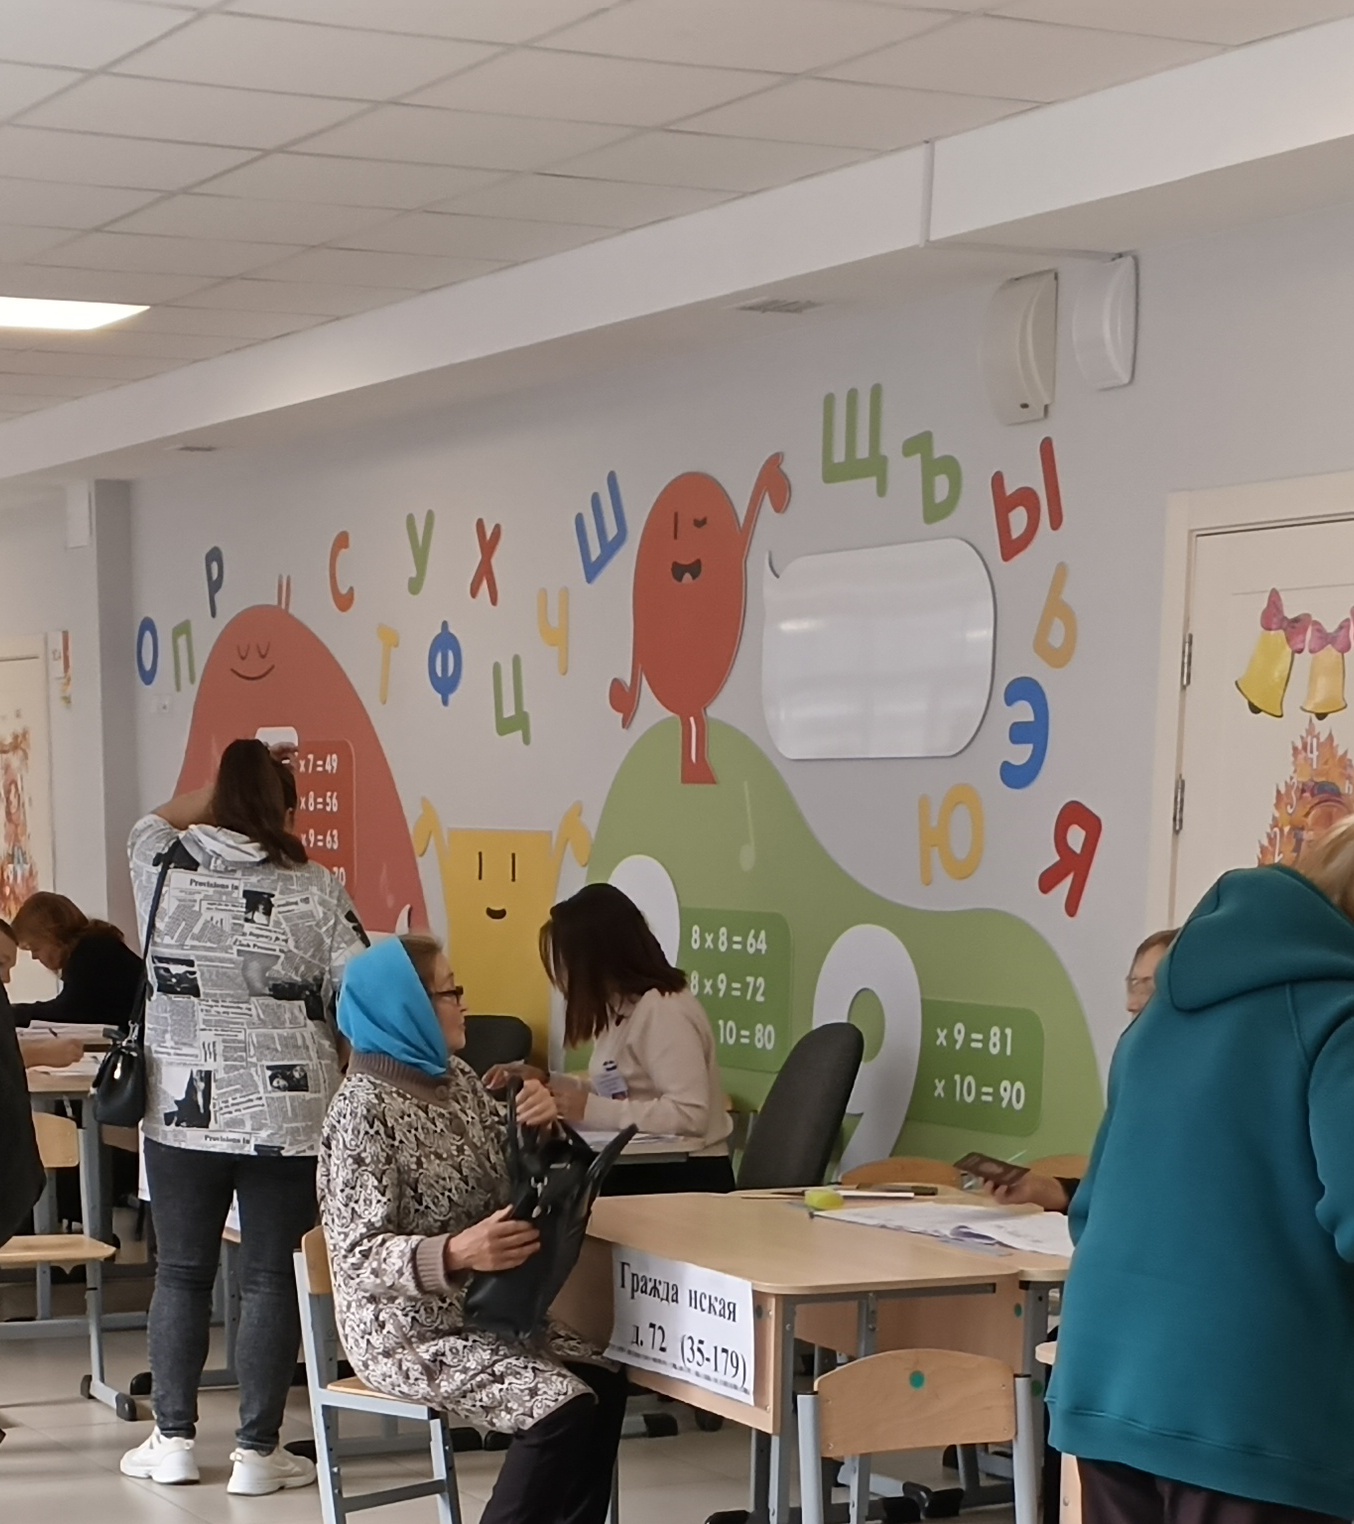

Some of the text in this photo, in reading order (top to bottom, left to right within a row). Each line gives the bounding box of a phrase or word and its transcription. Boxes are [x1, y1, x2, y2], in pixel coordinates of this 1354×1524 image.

[307, 754, 314, 773] 7
[325, 753, 338, 774] 49
[308, 791, 314, 811] 8
[325, 792, 338, 812] 56
[308, 829, 315, 848] 9
[325, 829, 338, 849] 63
[691, 924, 700, 950] 8
[718, 926, 728, 952] 8
[747, 929, 767, 955] 64
[690, 970, 699, 996] 8
[717, 973, 727, 997] 9
[746, 976, 765, 1002] 72
[718, 1019, 736, 1045] 10
[755, 1023, 775, 1050] 80
[954, 1022, 965, 1050] 9
[989, 1026, 1012, 1056] 81
[954, 1074, 976, 1103] 10
[1000, 1080, 1025, 1110] 90
[619, 1261, 737, 1322] Гражда нская
[631, 1324, 643, 1347] д.
[648, 1322, 667, 1353] 72
[680, 1334, 746, 1388] (35-179)
